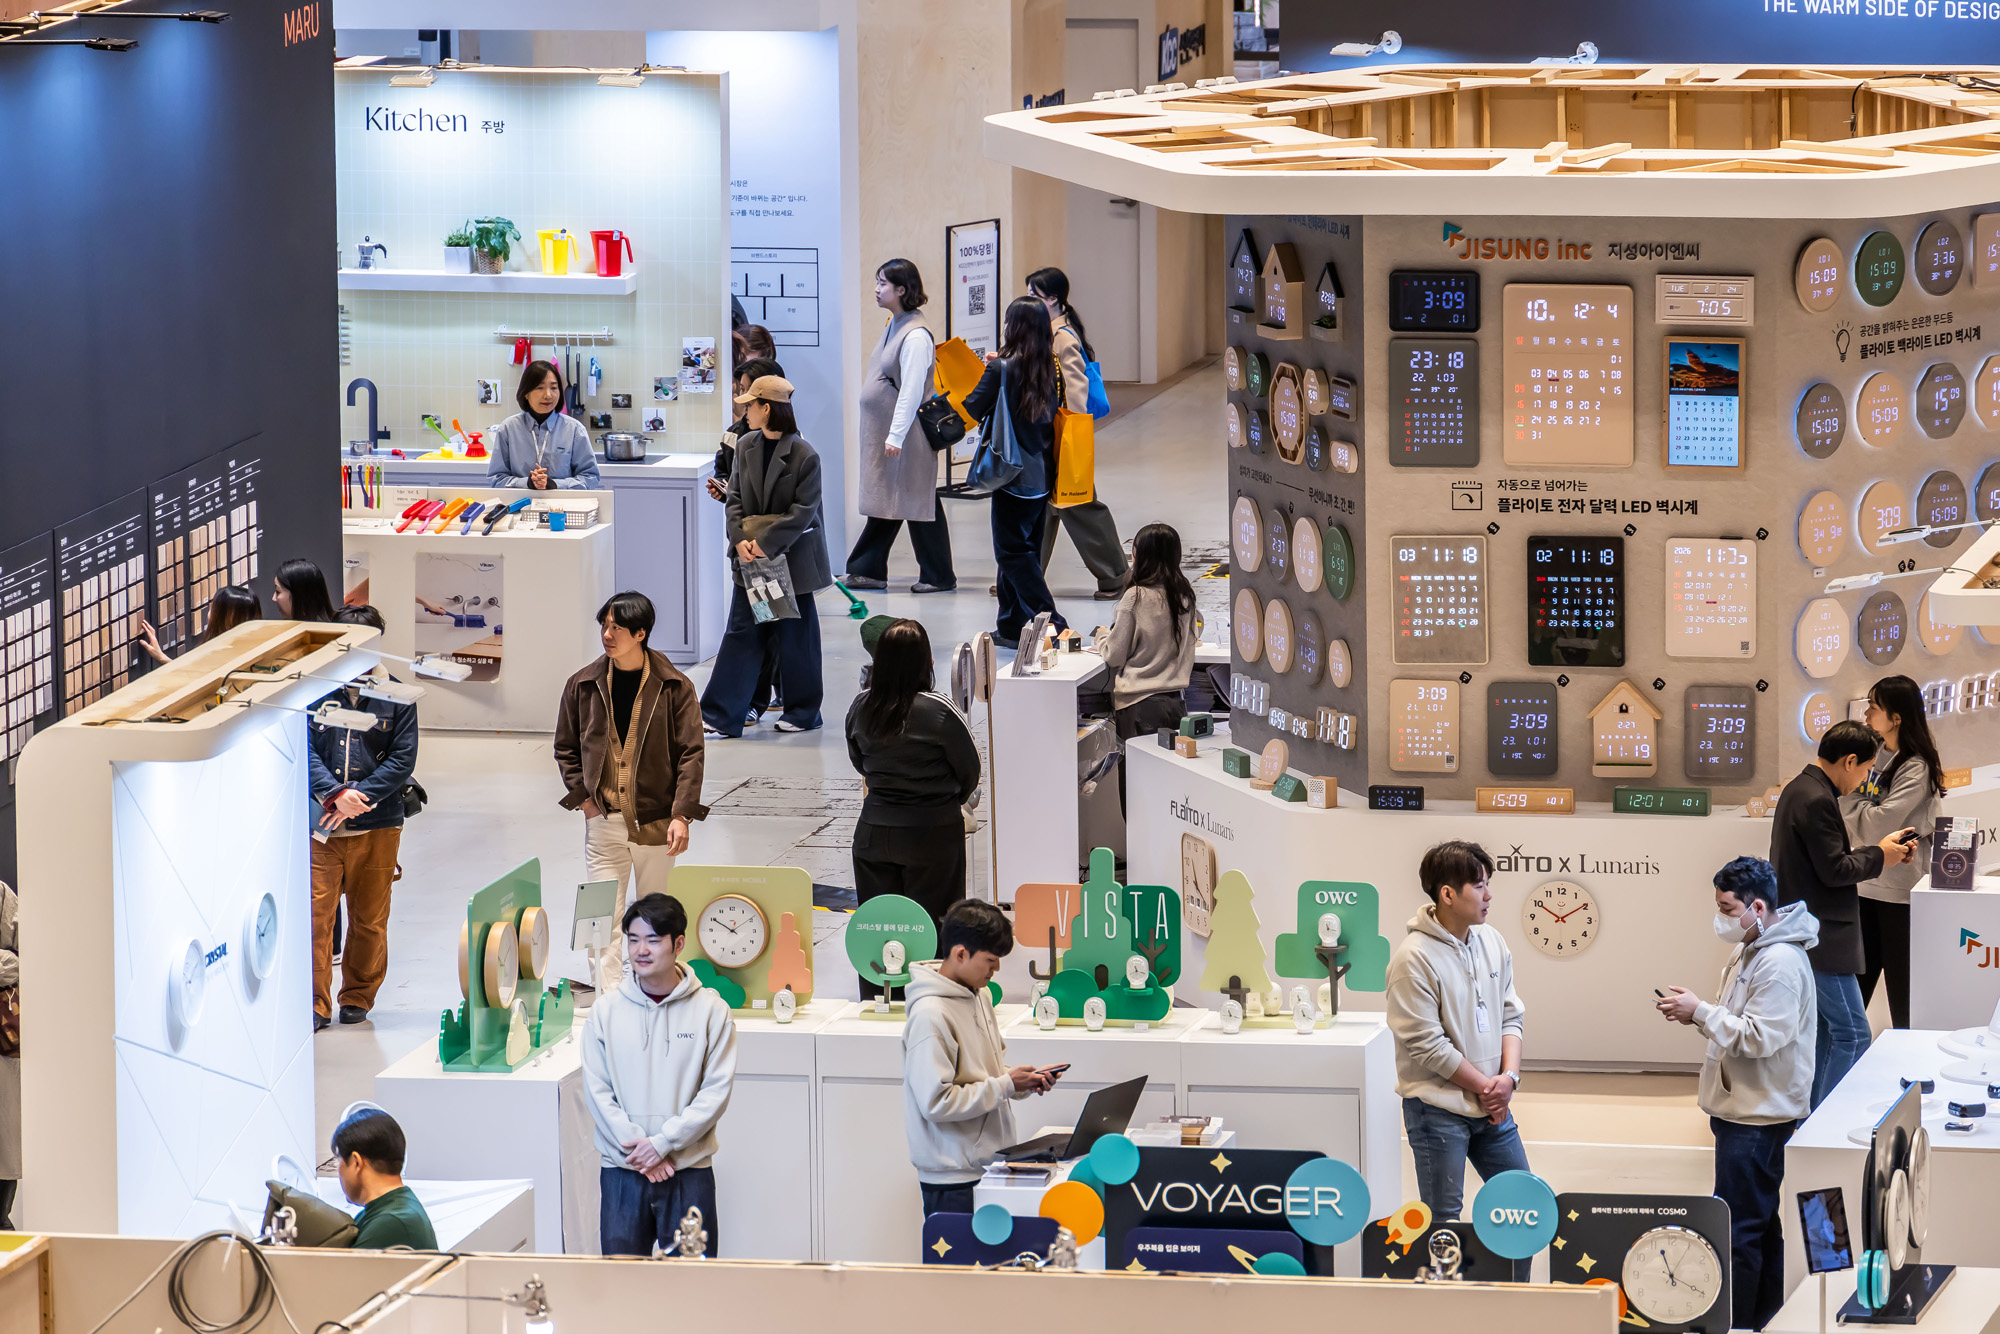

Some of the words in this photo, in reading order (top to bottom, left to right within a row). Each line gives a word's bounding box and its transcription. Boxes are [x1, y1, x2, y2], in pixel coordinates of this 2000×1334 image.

[1763, 0, 1797, 12] THE
[1804, 0, 1859, 15] WARM
[1865, 0, 1909, 17] SIDE
[1915, 0, 1939, 18] OF
[284, 2, 319, 47] MARU
[366, 107, 467, 132] Kitchen
[481, 121, 505, 134] 주방
[1459, 239, 1550, 261] JISUNG
[1558, 239, 1593, 261] inc
[1608, 242, 1700, 261] 지성아이엔씨
[1933, 250, 1955, 266] 3:36
[1810, 267, 1837, 284] 15:09
[1870, 261, 1896, 277] 15:09
[1424, 291, 1465, 309] 3:09
[1697, 300, 1731, 315] 7:05
[1607, 304, 1618, 318] 4
[1860, 325, 1881, 338] 공간을
[1883, 320, 1910, 334] 밝혀주는
[1911, 316, 1932, 330] 은은한
[1933, 312, 1953, 325] 무드등
[1860, 340, 1895, 360] 플라이토
[1897, 334, 1932, 353] 백라이트
[1934, 332, 1953, 348] LED
[1955, 326, 1981, 343] 벽시계
[1410, 351, 1464, 369] 23:18
[1280, 410, 1296, 428] 15:09
[1872, 406, 1899, 423] 15:09
[1812, 417, 1839, 435] 15:09
[1532, 431, 1542, 439] 31
[1497, 479, 1541, 491] 자동으로
[1544, 479, 1588, 492] 넘어가는
[1497, 498, 1555, 513] 플라이토
[1558, 499, 1586, 514] 전자
[1590, 499, 1617, 515] 달력
[1621, 500, 1652, 514] LED
[1656, 499, 1698, 516] 벽시계
[1931, 506, 1958, 523] 15:09
[1876, 506, 1901, 530] 3:09
[1399, 549, 1416, 562] 03
[1536, 550, 1553, 562] 02
[1674, 547, 1691, 555] 2026
[1874, 625, 1900, 642] 11:18
[1813, 635, 1840, 652] 15:09
[1234, 677, 1264, 714] 11:11
[1418, 687, 1448, 700] 3:09
[1319, 710, 1350, 749] 11:18
[1509, 714, 1548, 729] 3:09
[1707, 718, 1746, 734] 3:09
[1378, 796, 1404, 808] 15:09
[1492, 794, 1528, 807] 15:09
[1629, 795, 1664, 808] 12:01
[1207, 812, 1234, 841] Lunaris
[1578, 854, 1660, 875] Lunaris
[1315, 891, 1358, 905] OWC
[1534, 900, 1544, 908] 10
[1055, 891, 1169, 940] VISTA
[1587, 917, 1593, 925] 3
[856, 923, 882, 931] 크리스탈
[912, 924, 925, 932] 시간
[1534, 927, 1539, 935] 8
[1130, 1182, 1344, 1217] VOYAGER
[1490, 1208, 1539, 1226] OWC
[1658, 1208, 1688, 1216] COSMO
